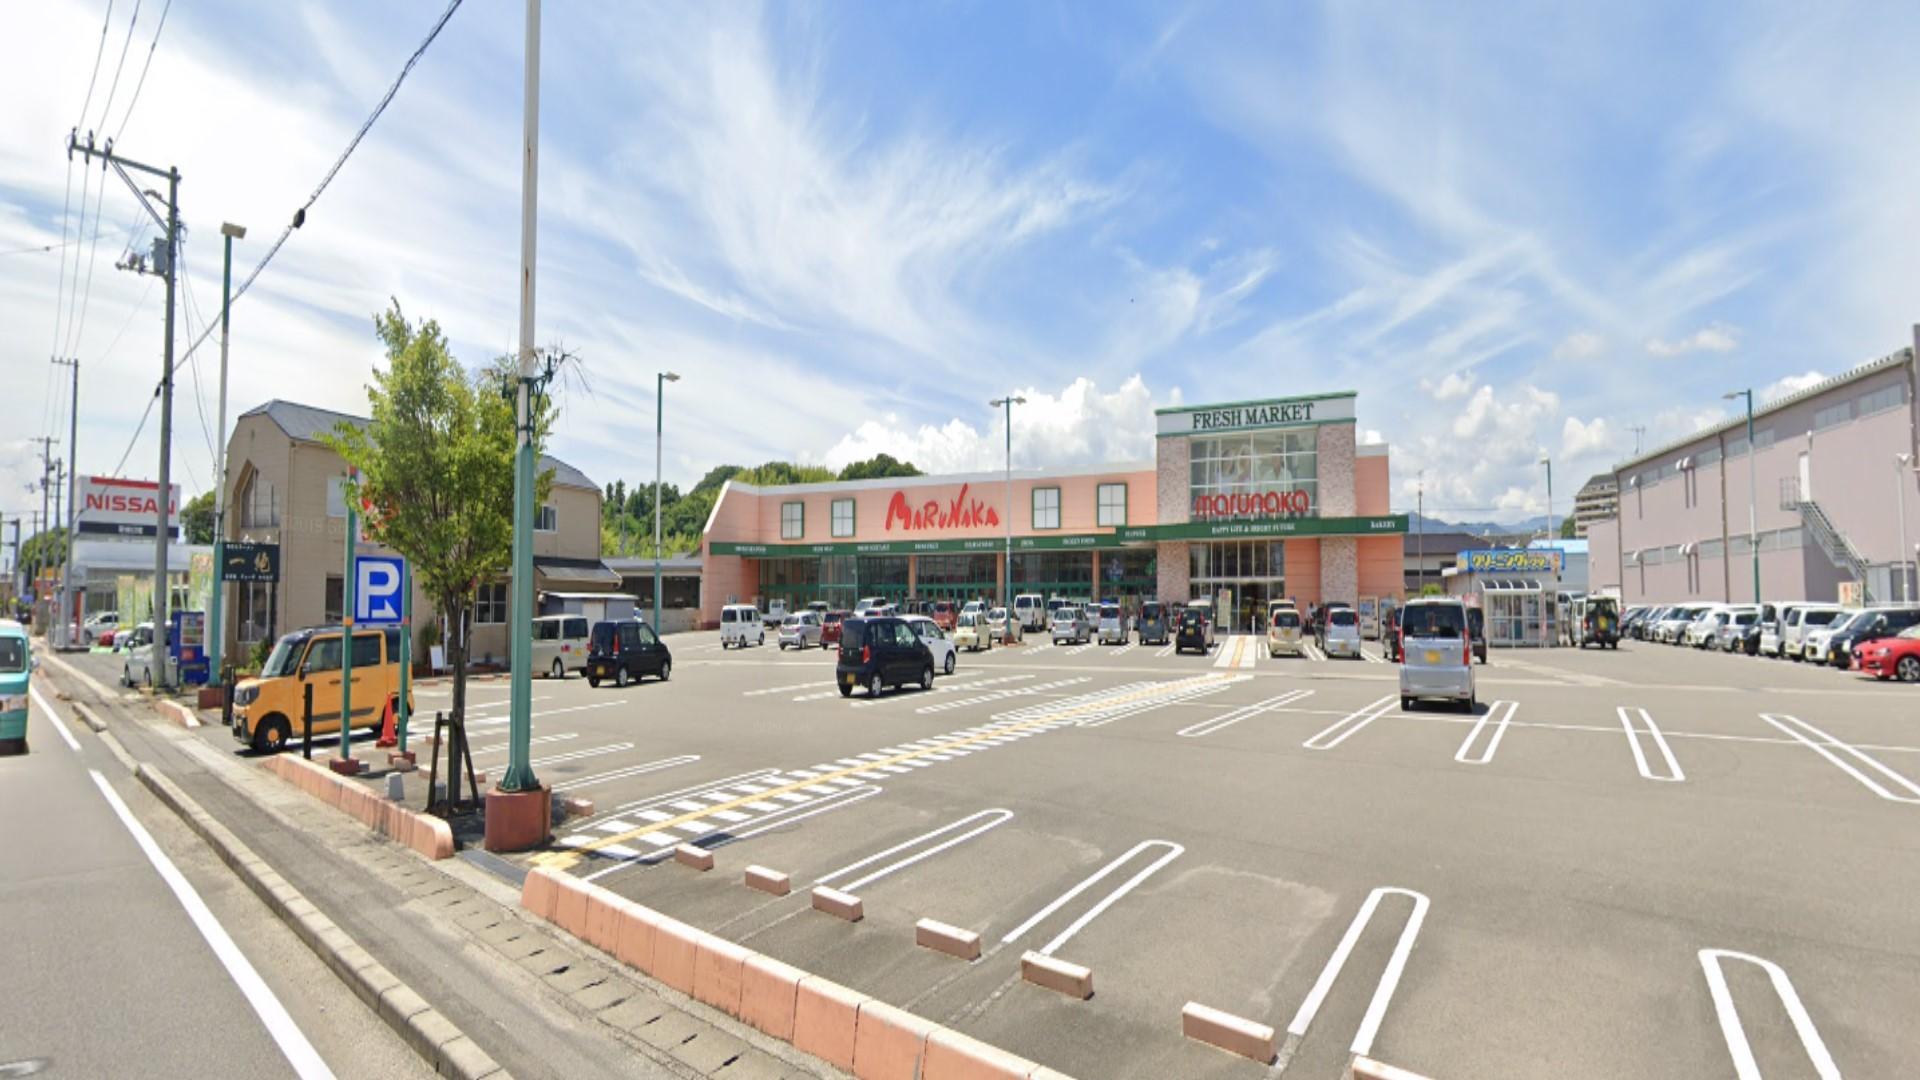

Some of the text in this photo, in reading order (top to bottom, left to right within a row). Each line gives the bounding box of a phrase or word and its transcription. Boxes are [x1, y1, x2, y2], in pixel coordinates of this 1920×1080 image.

[1192, 403, 1315, 429] FRESH MARKET
[1370, 520, 1396, 529] BAKERY
[357, 561, 400, 619] P
